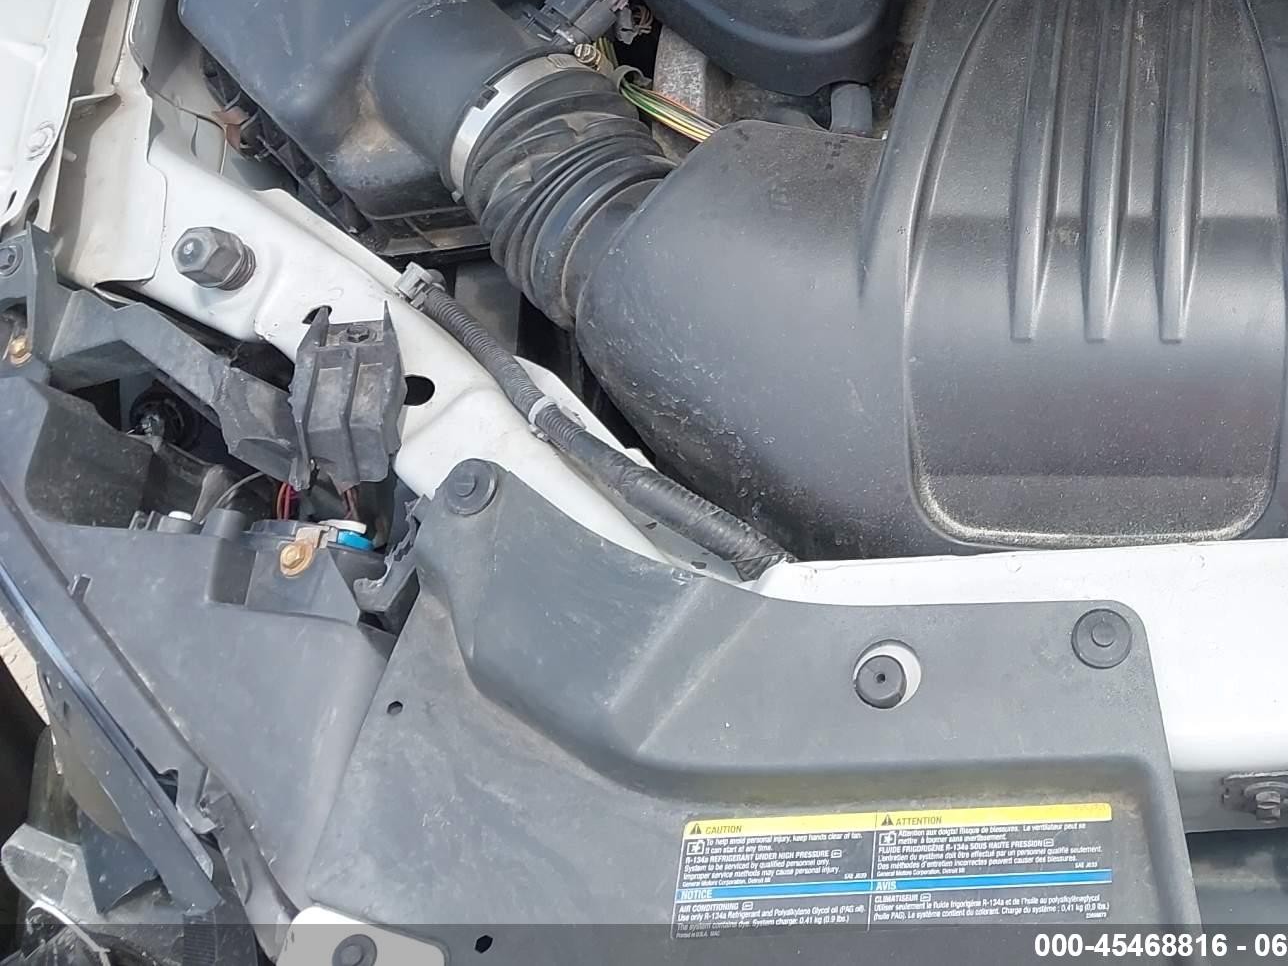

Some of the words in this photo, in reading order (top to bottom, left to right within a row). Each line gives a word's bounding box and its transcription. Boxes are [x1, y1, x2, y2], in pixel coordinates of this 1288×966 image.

[896, 816, 942, 826] ATTENTION
[706, 826, 742, 834] CAUTION
[959, 827, 980, 836] Risque
[1064, 823, 1077, 831] peut
[715, 838, 728, 846] help
[746, 836, 772, 845] personal
[793, 835, 808, 843] keep
[879, 846, 901, 854] FLUIDE
[946, 843, 968, 851] R-134a
[970, 842, 987, 850] SOUS
[989, 841, 1010, 849] HAUTE
[1011, 840, 1042, 848] PRESSION
[685, 856, 708, 864] R-134a
[710, 854, 753, 862] REFRIGERANT
[795, 851, 829, 859] PRESSURE
[919, 853, 944, 862] système
[1017, 848, 1046, 857] personnel
[1070, 845, 1102, 853] seulement.
[685, 865, 707, 873] System
[751, 862, 758, 870] by
[760, 861, 785, 870] qualified
[786, 860, 815, 869] personnel
[891, 861, 919, 869] méthodes
[954, 858, 987, 866] incorrectes
[989, 857, 1012, 866] peuvent
[1047, 854, 1077, 862] blessures.
[684, 872, 710, 881] Improper
[795, 867, 821, 876] personal
[822, 866, 840, 875] injury.
[876, 881, 896, 891] AVIS
[681, 890, 712, 900] NOTICE
[875, 894, 918, 903] CLIMATISEUR
[679, 905, 691, 913] AIR
[692, 903, 739, 912] CONDITIONING
[933, 901, 949, 909] fluide
[1022, 897, 1038, 905] l'huile
[690, 913, 703, 922] only
[704, 912, 726, 920] R-134a
[728, 911, 760, 920] Refrigerant
[774, 908, 810, 918] Polyalkylene
[812, 907, 830, 916] Glycol
[840, 906, 854, 915] (PAG
[874, 913, 889, 921] (huile
[917, 910, 940, 919] système
[942, 909, 965, 917] contient
[1002, 907, 1021, 915] Charge
[1032, 905, 1056, 914] système
[1061, 904, 1074, 913] 0,41
[1076, 904, 1083, 912] kg
[1084, 903, 1096, 912] (0,9
[689, 922, 710, 931] system
[753, 919, 774, 928] System
[776, 918, 797, 927] charge:
[799, 917, 812, 925] 0.41
[814, 917, 822, 925] kg
[824, 916, 835, 925] (0.9
